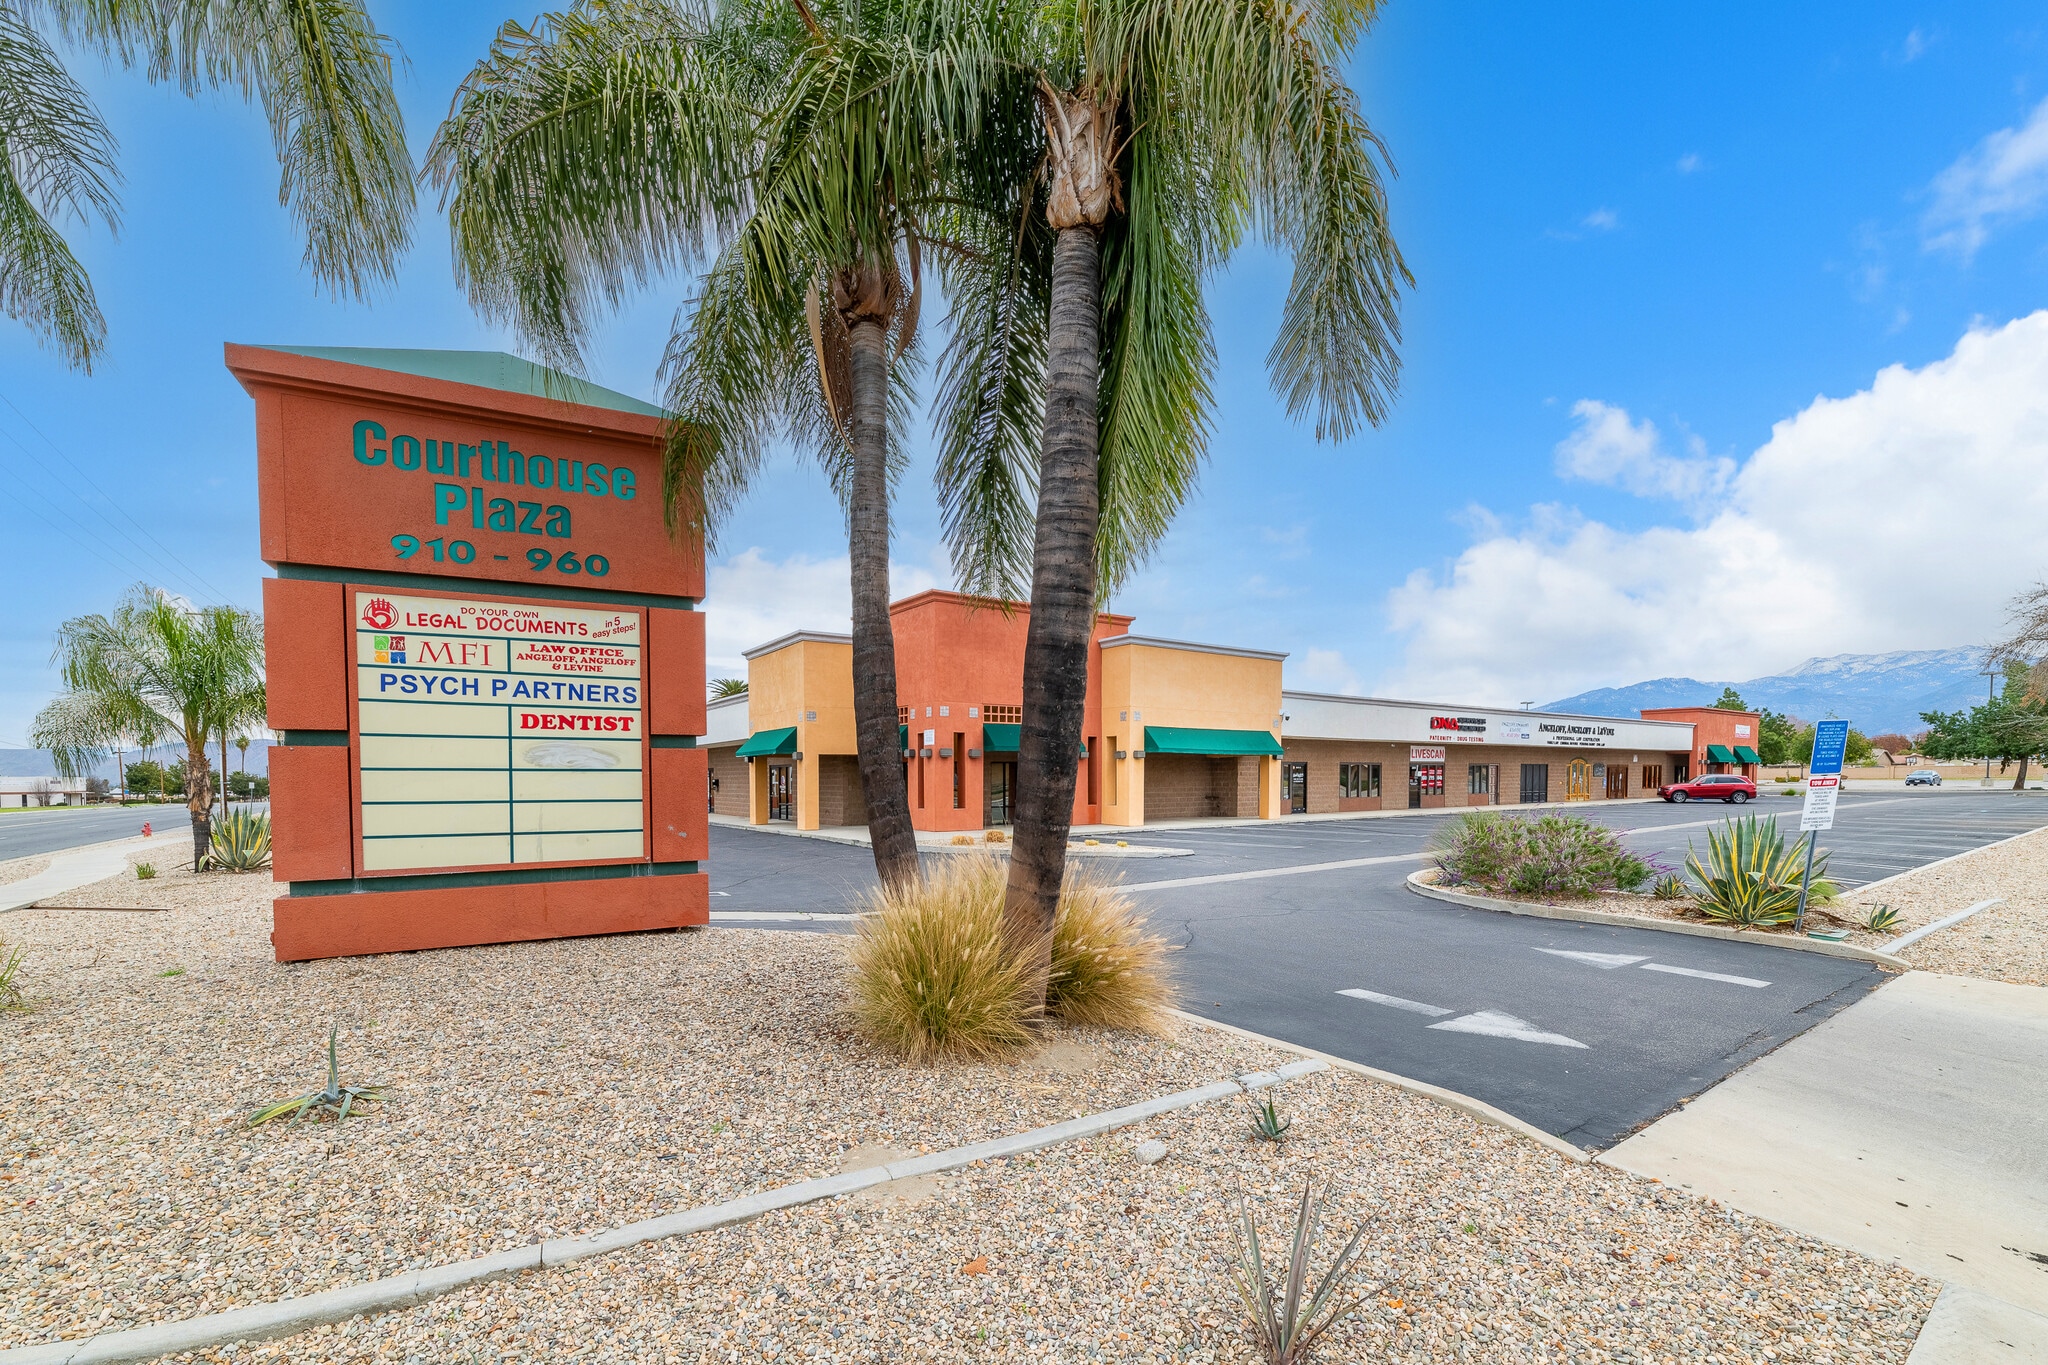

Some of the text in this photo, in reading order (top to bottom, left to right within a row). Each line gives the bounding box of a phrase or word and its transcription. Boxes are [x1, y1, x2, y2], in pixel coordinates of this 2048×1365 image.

[353, 420, 636, 500] Courthouse
[434, 482, 572, 539] Plaza
[391, 533, 476, 565] 910
[525, 548, 610, 577] 960
[460, 607, 539, 619] DO YOUR OWN
[406, 612, 588, 636] LEGAL DOCUMENTS
[592, 622, 636, 638] easy steps!
[605, 616, 621, 628] in 5
[416, 640, 492, 666] MFI
[530, 643, 624, 657] LAW OFFICE
[516, 653, 636, 666] ANGELOFF, ANGELOFF
[552, 663, 603, 673] & LEVINE
[380, 673, 637, 704] PSYCH PARTNERS
[520, 713, 635, 732] DENTIST
[1430, 717, 1459, 731] DNA
[1411, 748, 1445, 759] LIVESCAN
